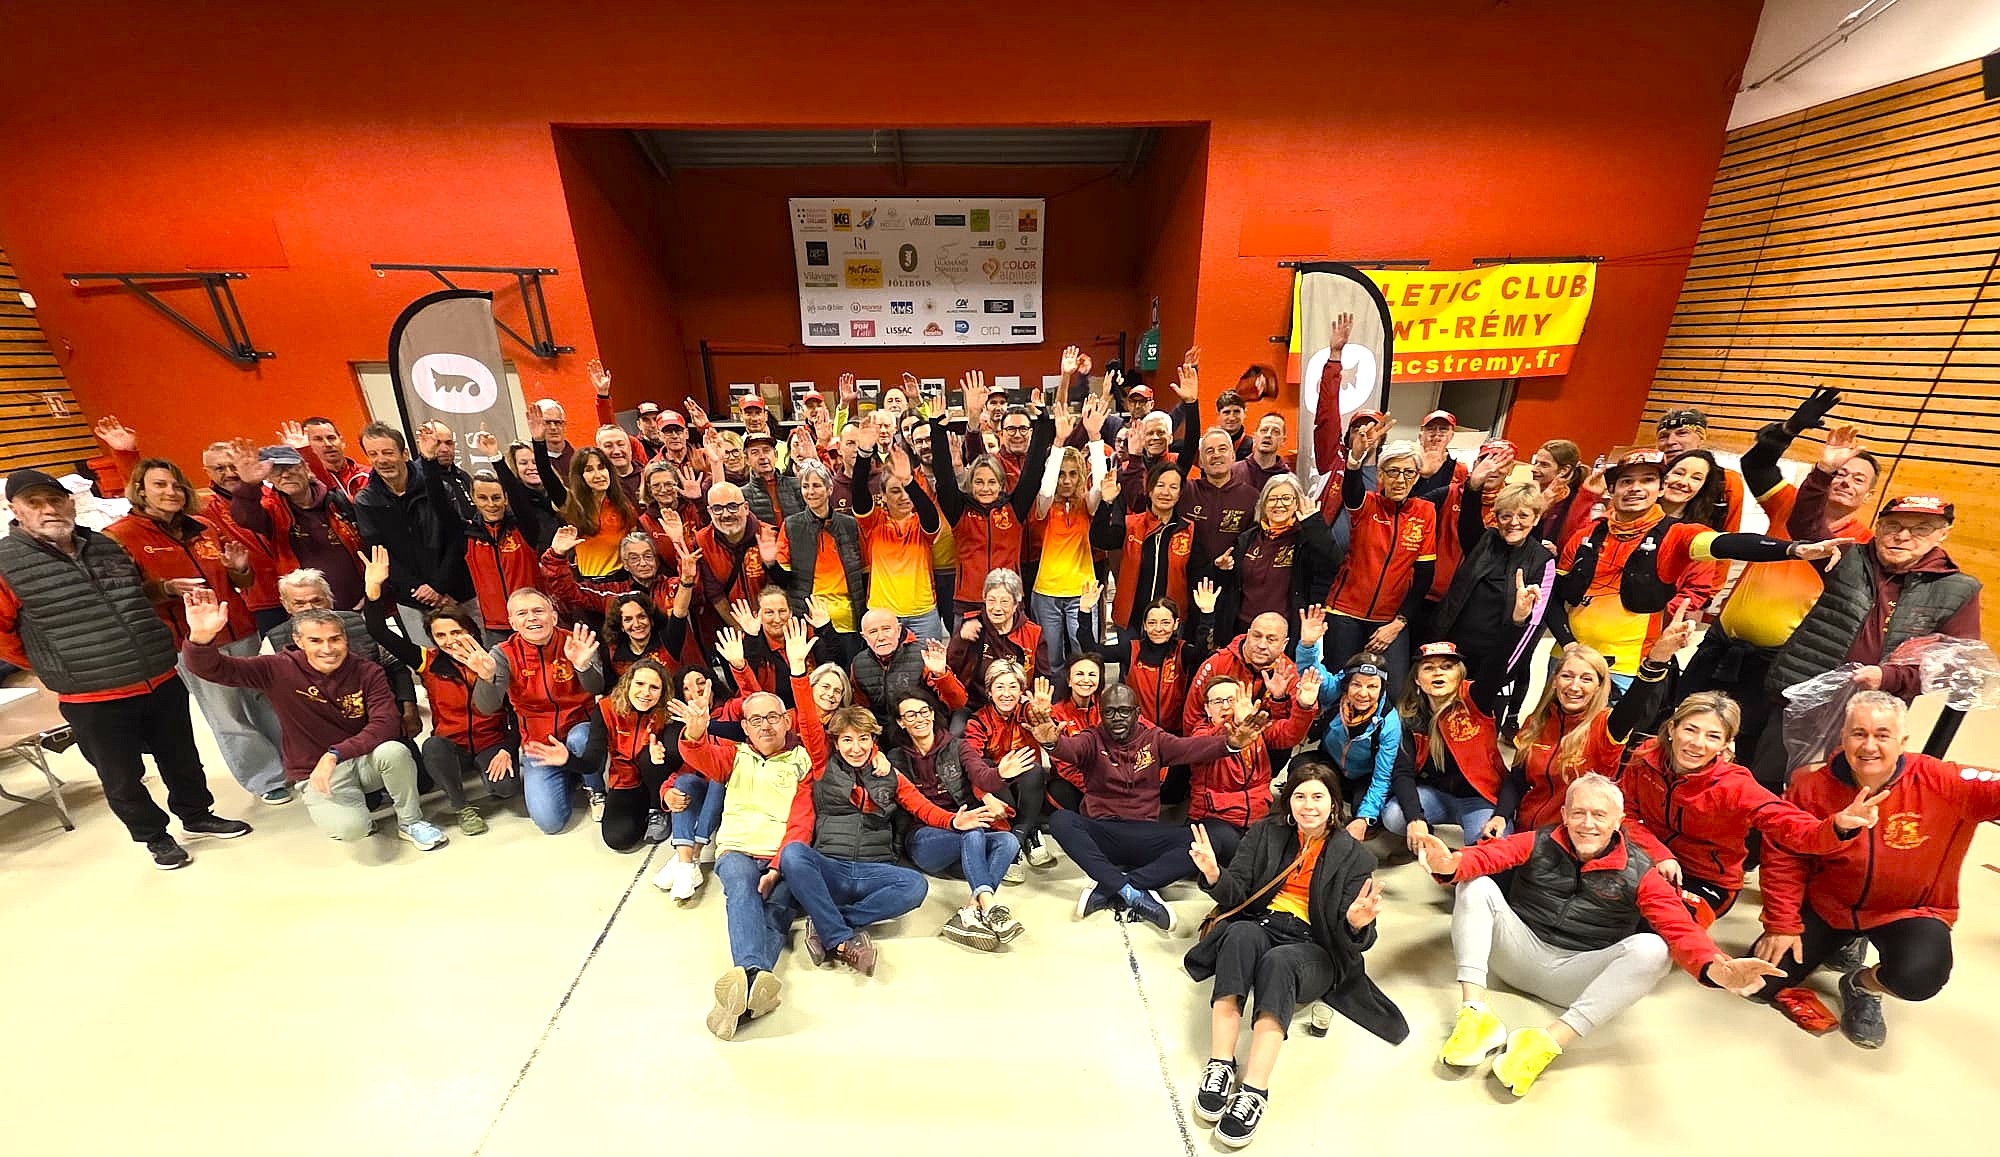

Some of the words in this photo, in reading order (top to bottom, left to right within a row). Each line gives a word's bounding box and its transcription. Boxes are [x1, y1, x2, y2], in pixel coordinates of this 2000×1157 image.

[1002, 260, 1037, 270] COLOR
[1000, 270, 1037, 281] alpilles
[888, 279, 932, 288] JOLIBOIS
[1382, 279, 1481, 307] LETIC
[1501, 275, 1587, 300] CLUB
[891, 305, 913, 314] KMS
[886, 326, 912, 334] LISSAC
[1393, 309, 1552, 341] NT-RÉMY
